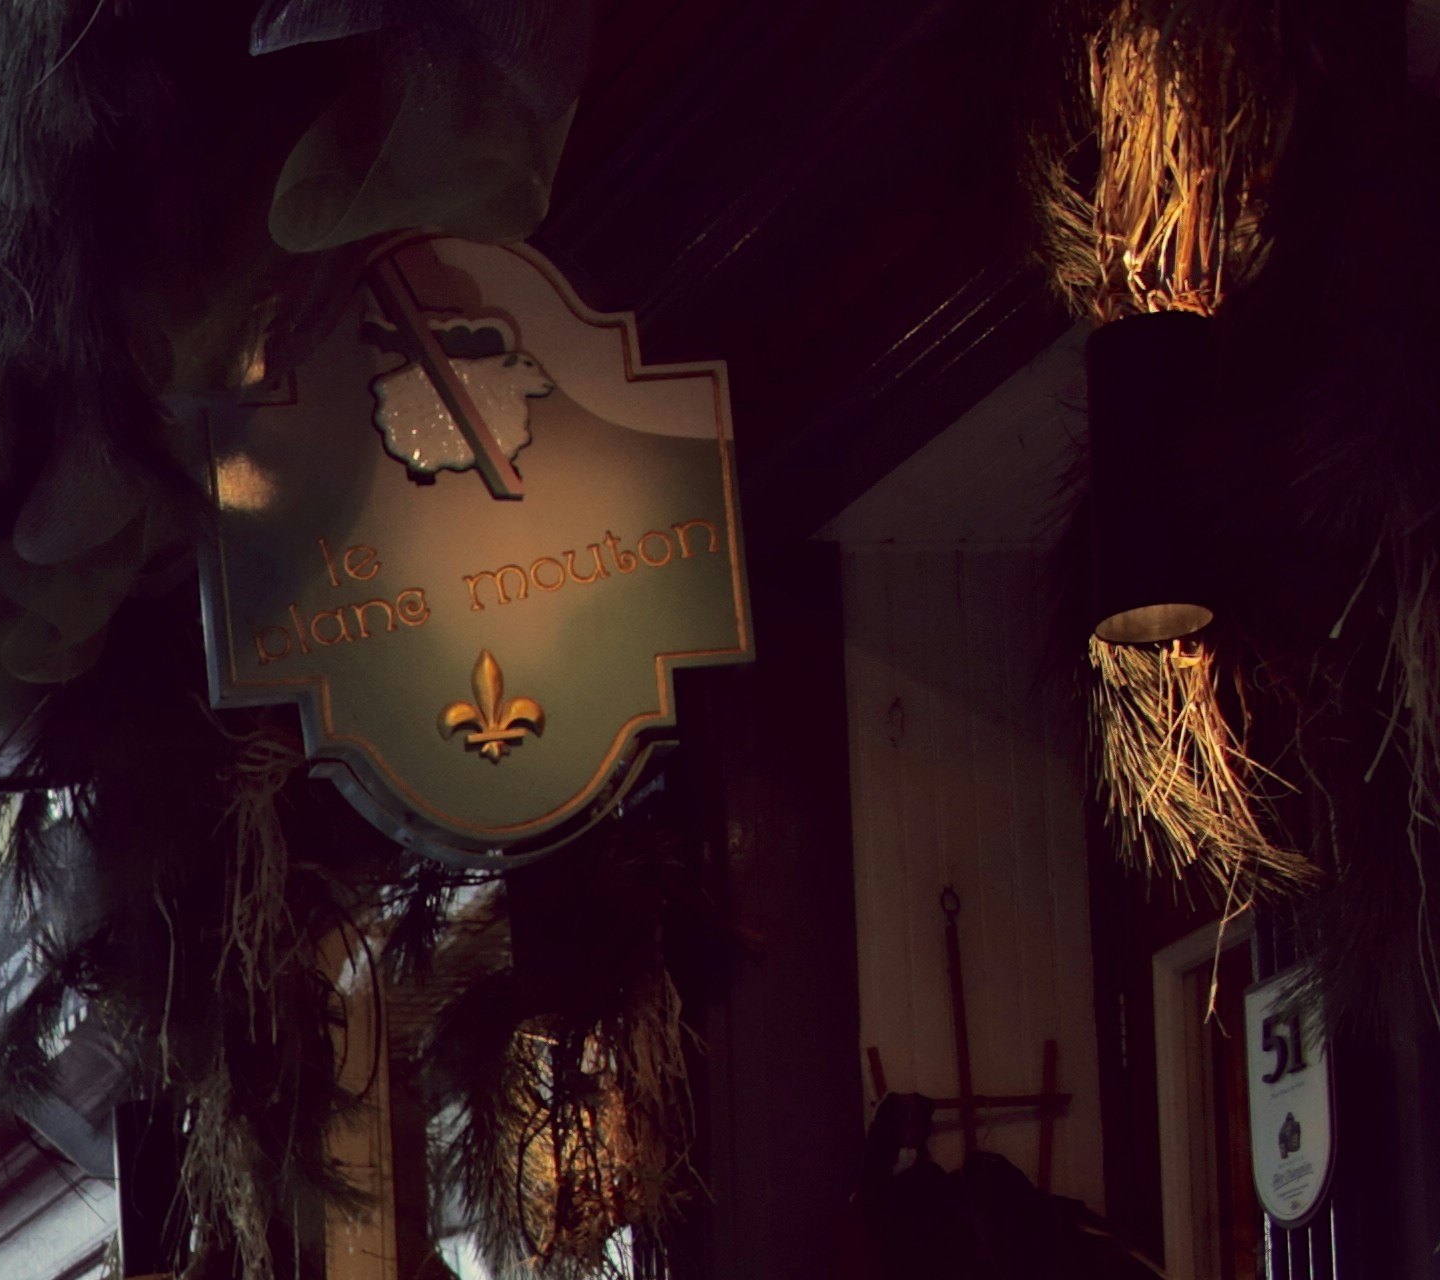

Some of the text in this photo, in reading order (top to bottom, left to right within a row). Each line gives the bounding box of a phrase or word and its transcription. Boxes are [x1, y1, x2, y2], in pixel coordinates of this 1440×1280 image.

[318, 538, 382, 587] le
[463, 516, 724, 612] mouton
[1261, 1009, 1308, 1084] 51
